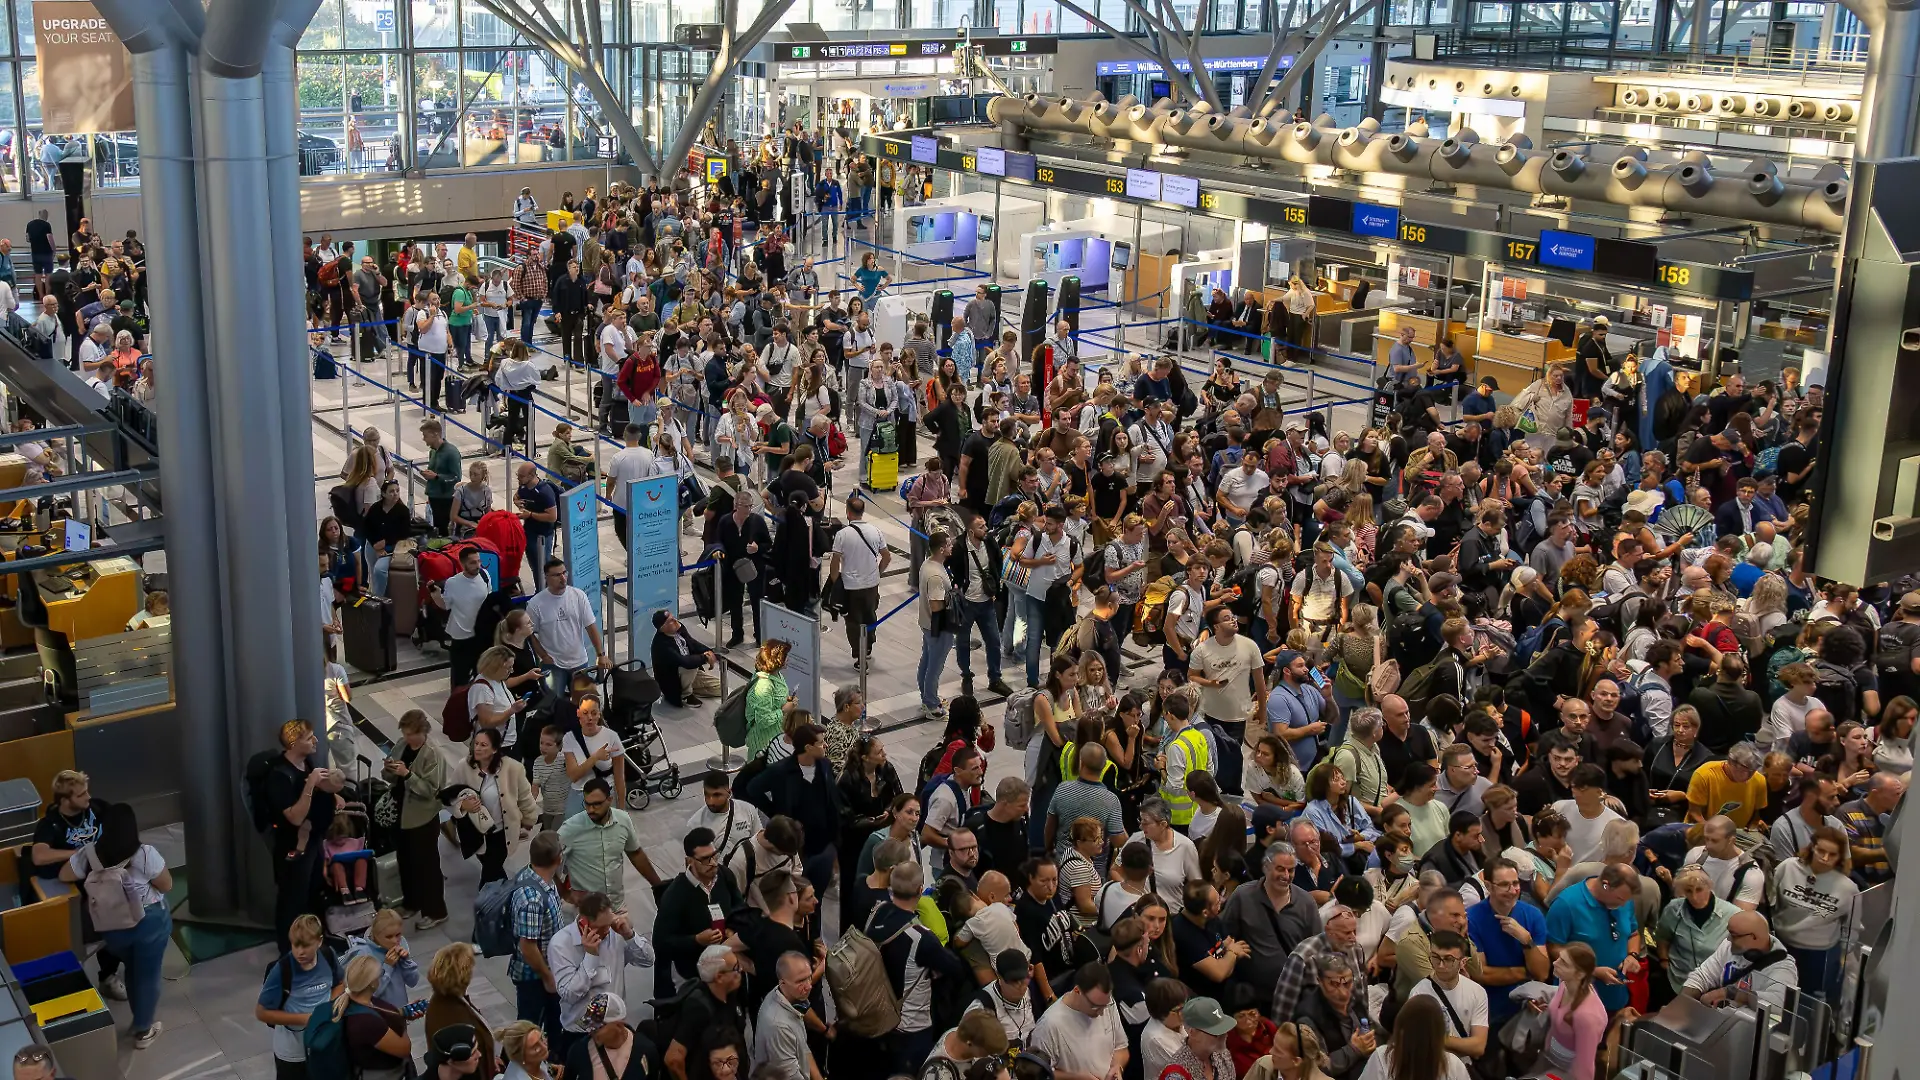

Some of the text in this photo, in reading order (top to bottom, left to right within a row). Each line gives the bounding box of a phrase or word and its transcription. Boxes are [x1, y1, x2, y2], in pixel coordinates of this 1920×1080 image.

[42, 18, 107, 30] UPGRADE
[377, 12, 393, 26] P5
[43, 32, 114, 44] YOUR SEAT.
[885, 143, 898, 155] 150
[961, 156, 976, 169] 151
[1037, 168, 1054, 183] 152
[1106, 178, 1124, 194] 153
[1200, 193, 1220, 208] 154
[1284, 206, 1305, 224] 155
[1401, 225, 1426, 243] 156
[1507, 241, 1535, 260] 157
[1659, 265, 1690, 285] 158
[638, 509, 671, 520] Check-in
